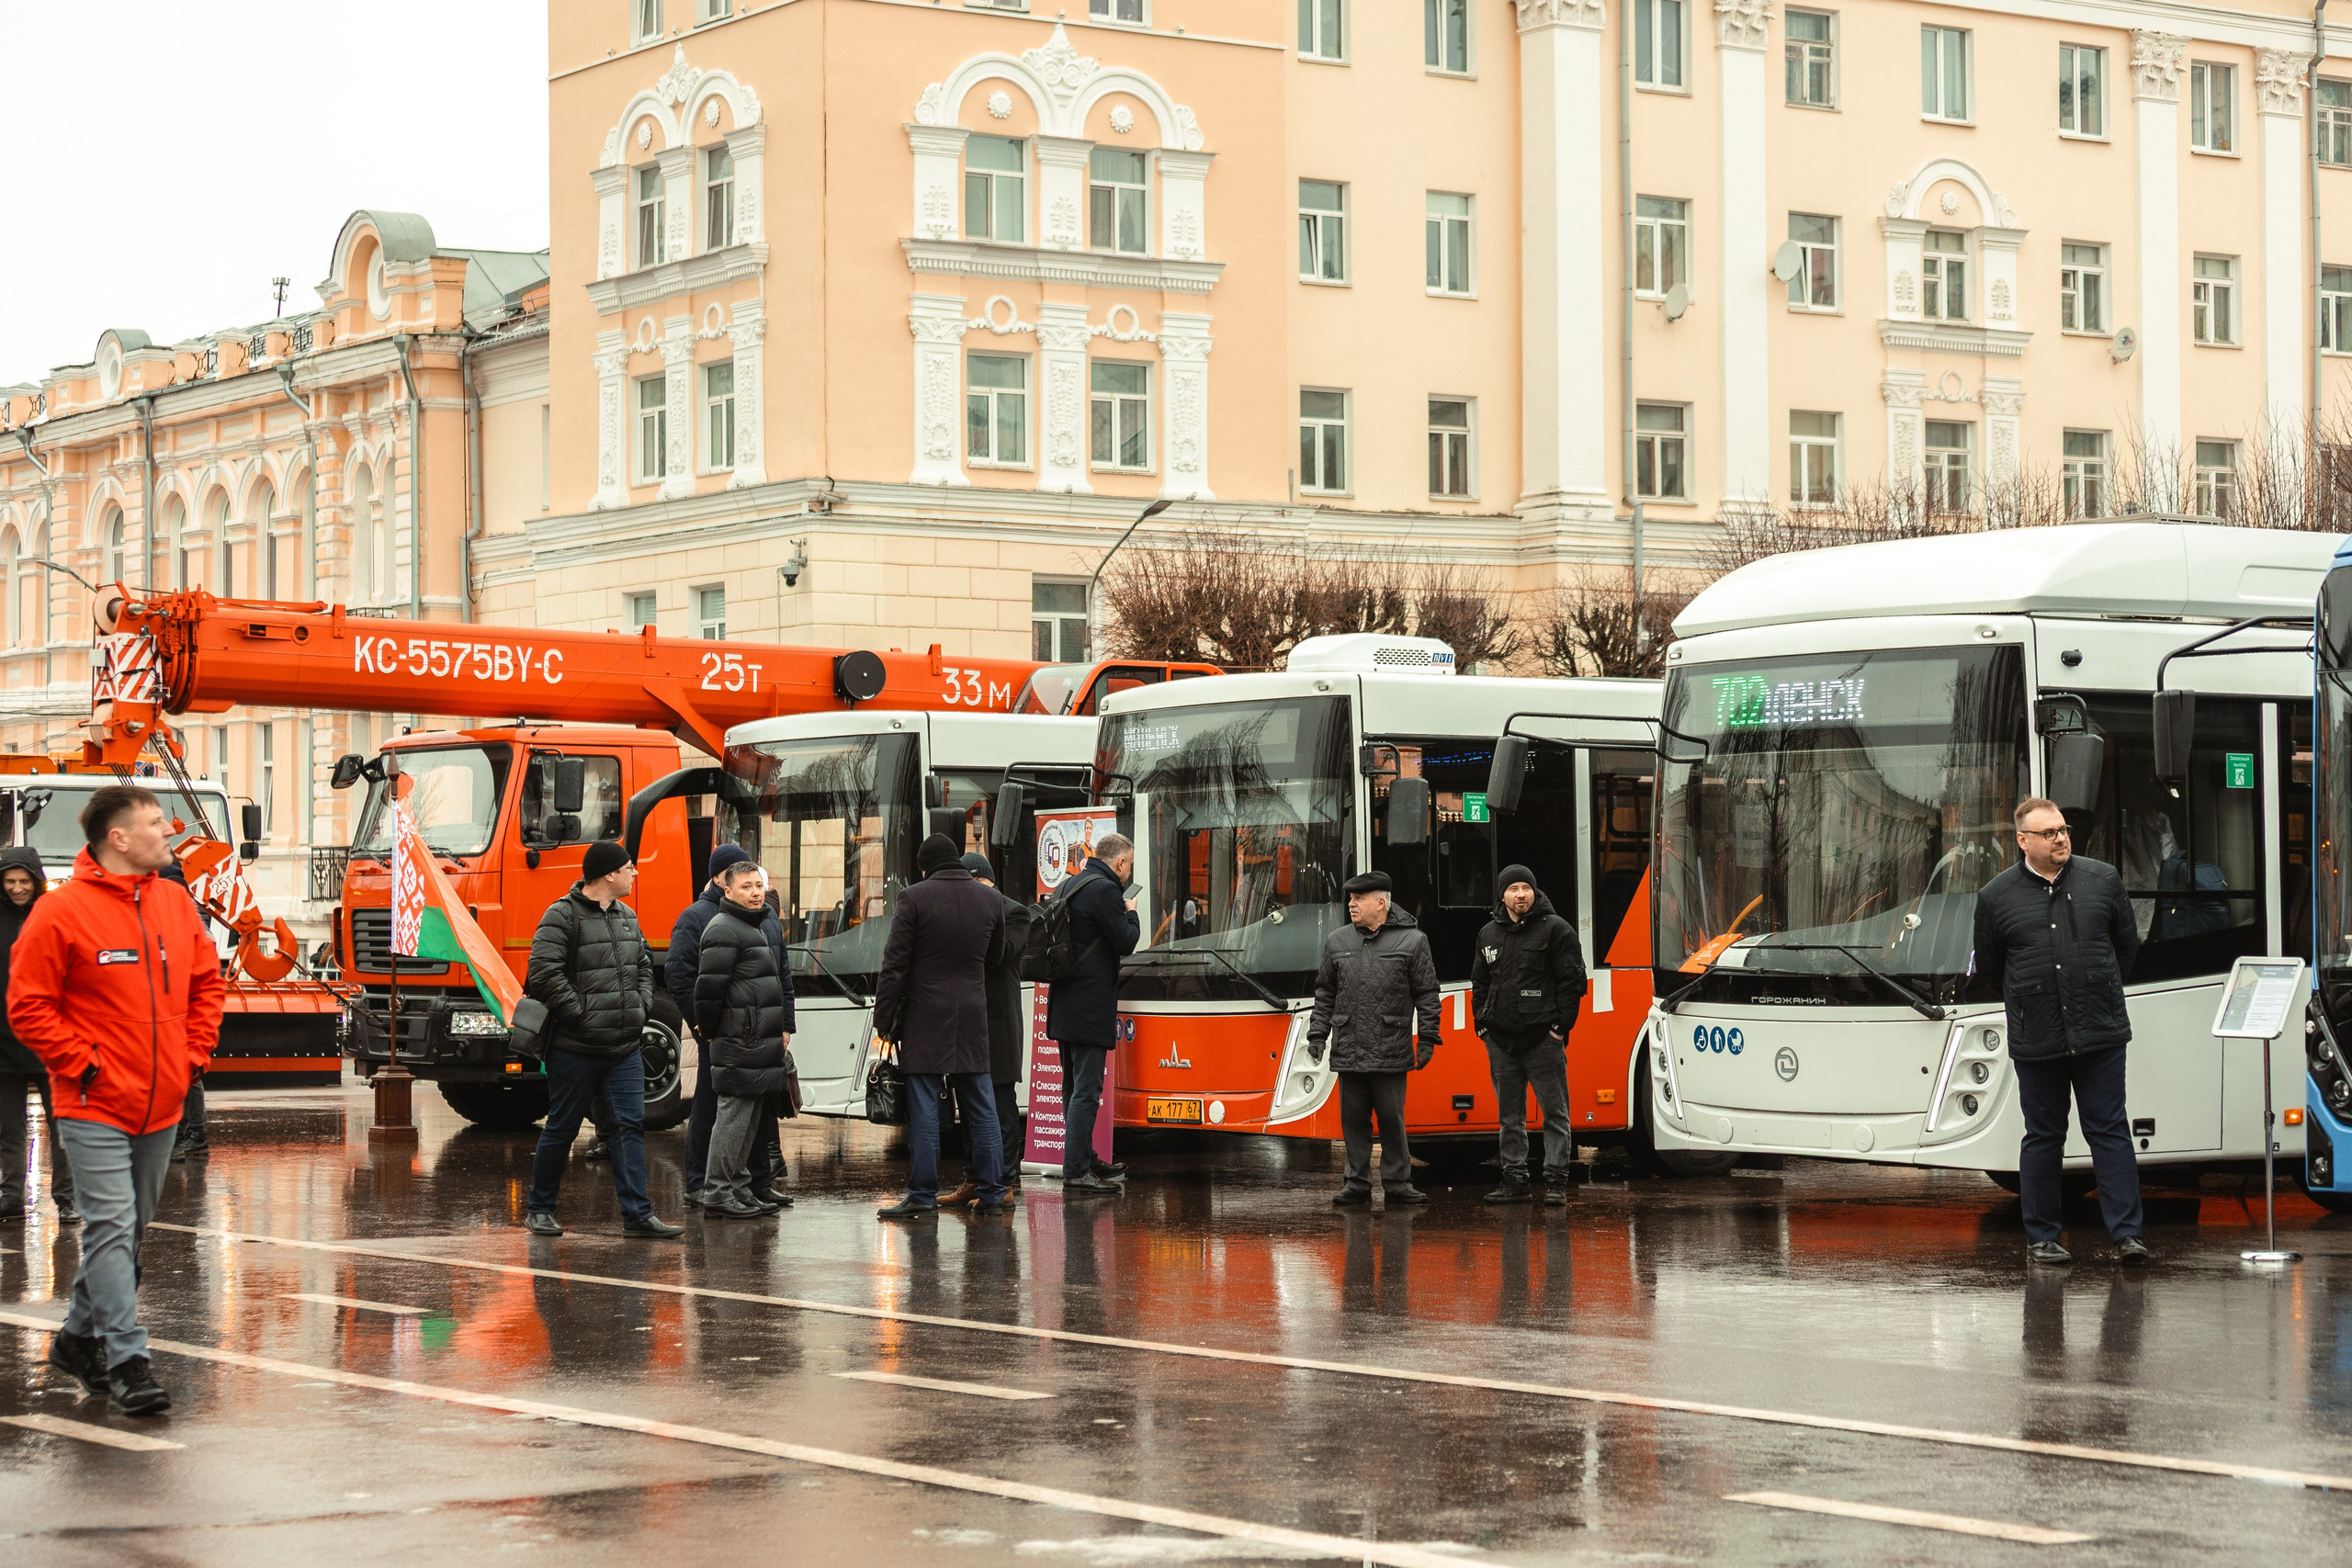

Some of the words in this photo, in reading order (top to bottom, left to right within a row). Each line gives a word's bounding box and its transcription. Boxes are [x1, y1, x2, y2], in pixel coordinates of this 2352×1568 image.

[1750, 996, 1826, 1004] ГОРОЖАНИН
[1167, 1101, 1183, 1118] 177
[1187, 1101, 1197, 1114] 67
